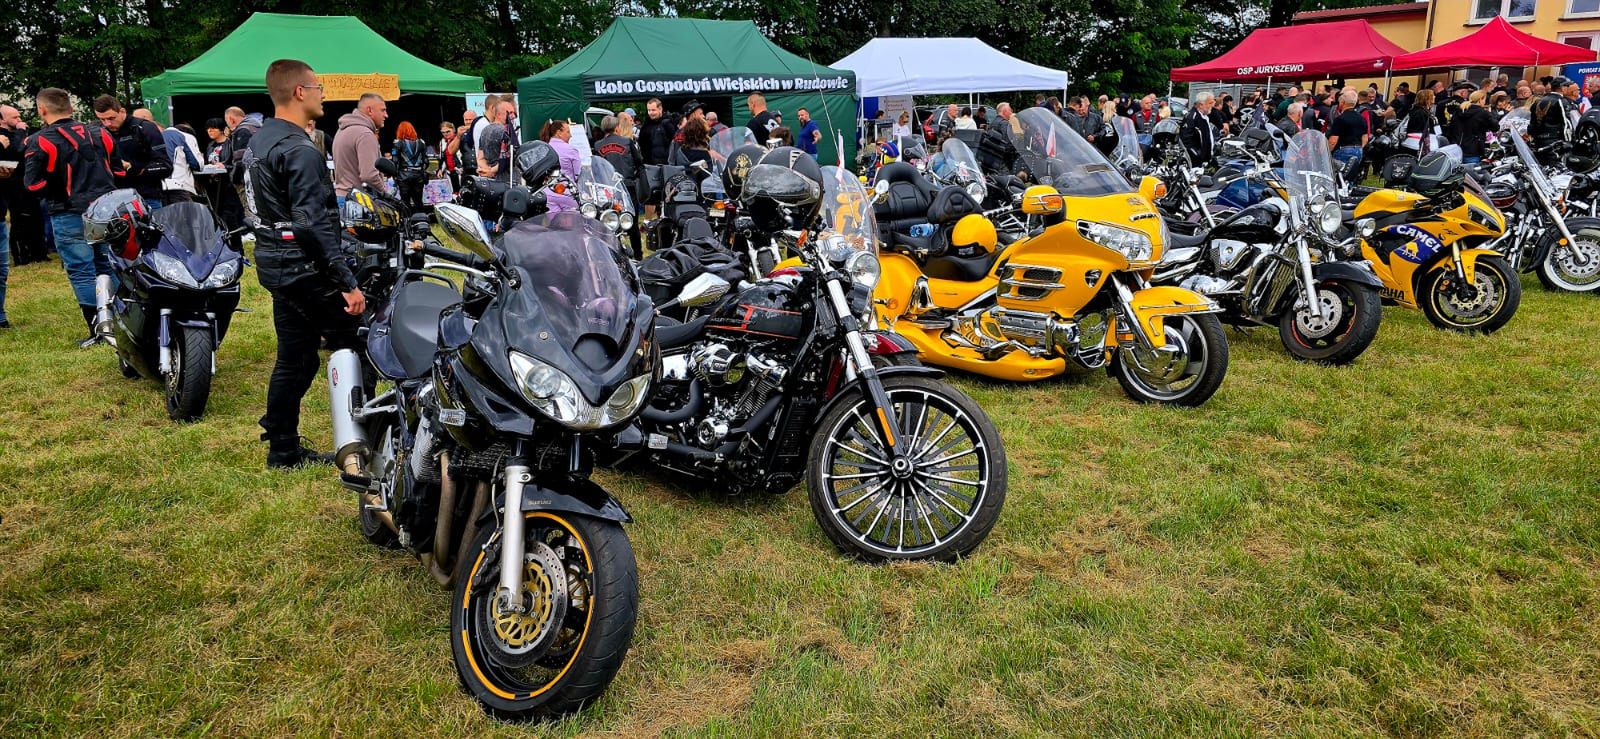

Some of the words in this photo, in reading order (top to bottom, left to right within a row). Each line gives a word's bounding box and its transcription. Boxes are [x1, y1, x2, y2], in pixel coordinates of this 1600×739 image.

[1237, 67, 1254, 75] OSP
[1254, 64, 1304, 74] JURYSZEWO
[635, 77, 711, 94] Gospodyń
[712, 76, 779, 92] Wiejskich
[781, 79, 794, 90] w
[794, 76, 848, 90] Rudowie
[1397, 225, 1441, 253] CAMEL
